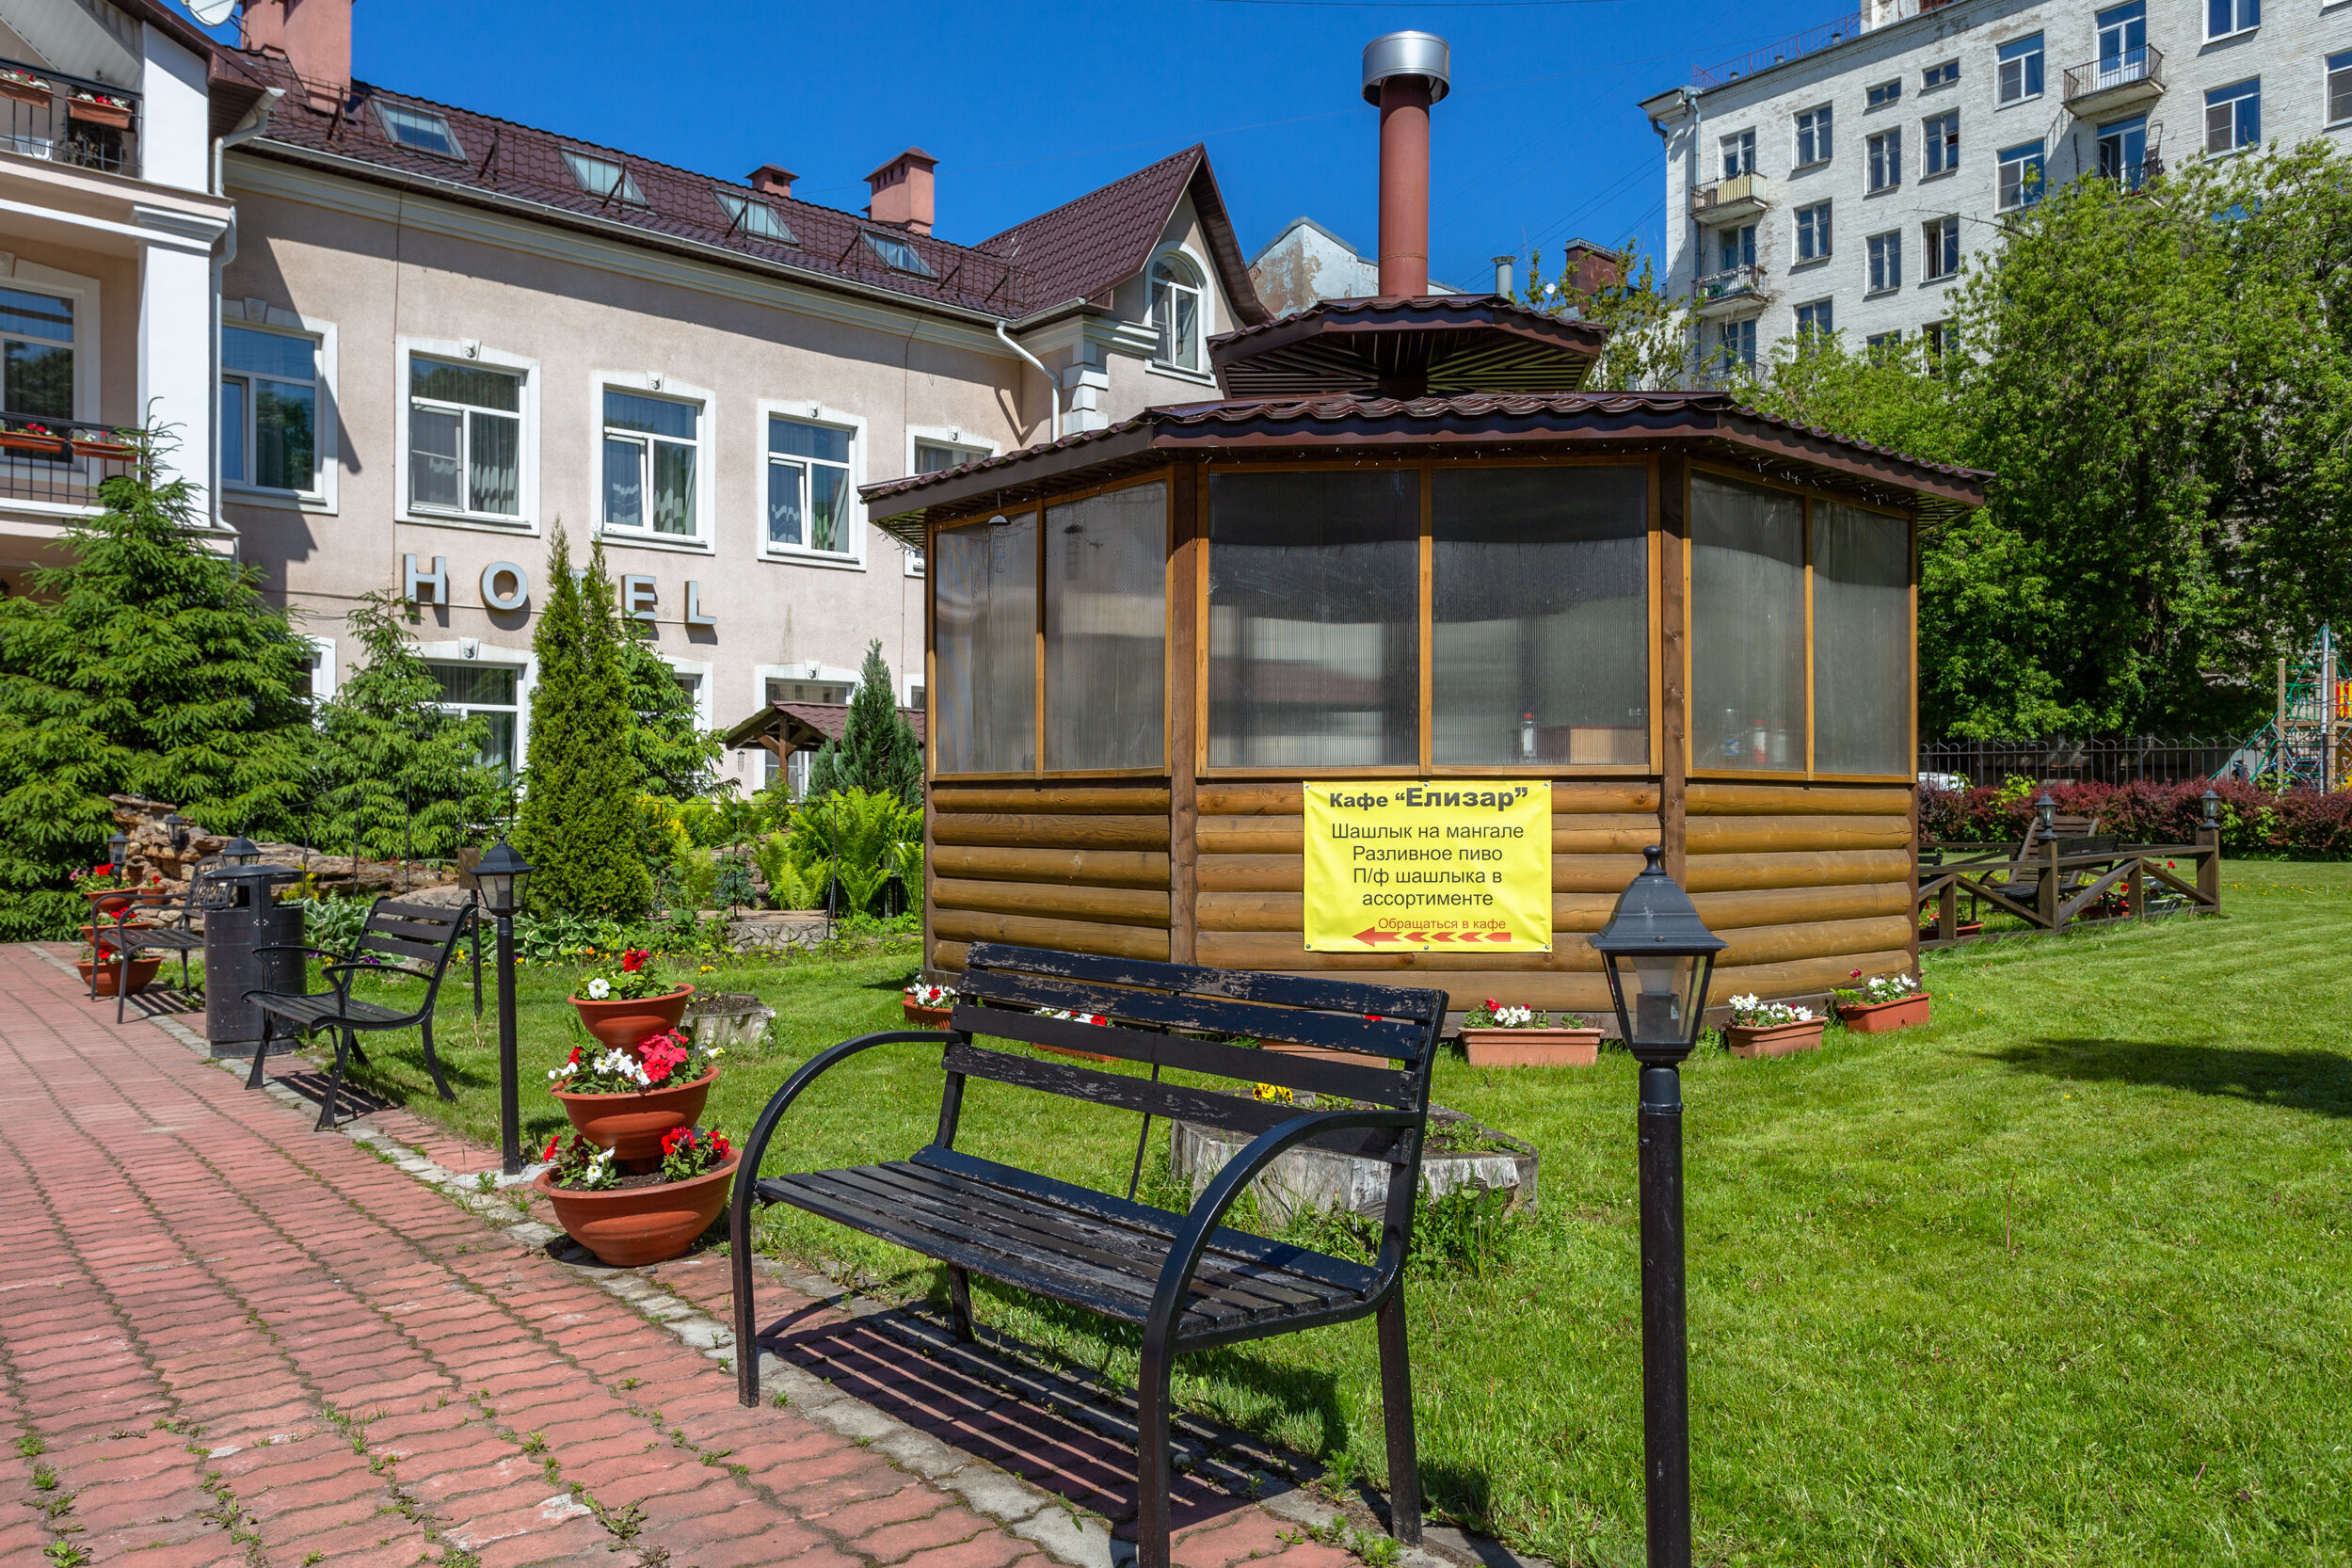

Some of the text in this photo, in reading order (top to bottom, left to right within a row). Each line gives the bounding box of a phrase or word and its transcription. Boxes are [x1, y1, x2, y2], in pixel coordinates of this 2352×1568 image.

[1330, 787, 1528, 811] Кафе “Елизар”
[1332, 824, 1524, 839] Шашлык на мангале
[1352, 846, 1503, 860] Разливное пиво
[1353, 868, 1502, 887] П/ф шашлыка в
[1362, 894, 1494, 909] ассортименте
[1378, 918, 1506, 931] Обращаться в кафе
